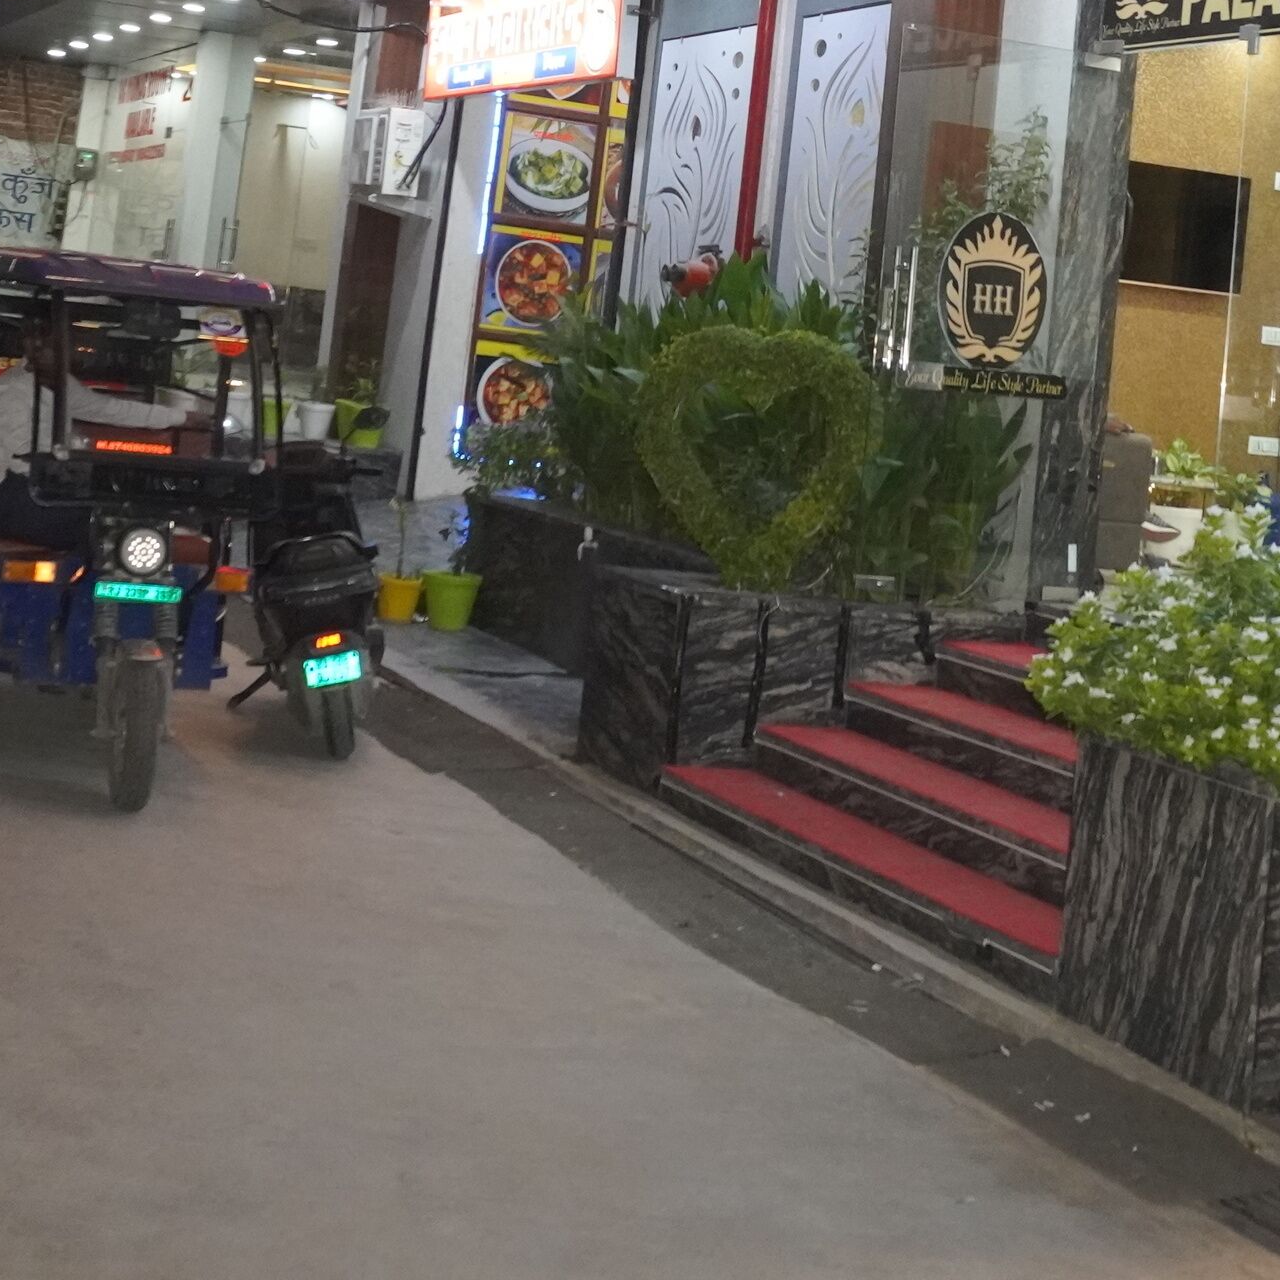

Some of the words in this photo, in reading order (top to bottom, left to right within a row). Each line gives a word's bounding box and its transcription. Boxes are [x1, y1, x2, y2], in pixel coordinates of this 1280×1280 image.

[973, 283, 1014, 317] HH
[970, 368, 997, 394] Life
[998, 373, 1024, 399] Style
[1025, 375, 1063, 396] Partner
